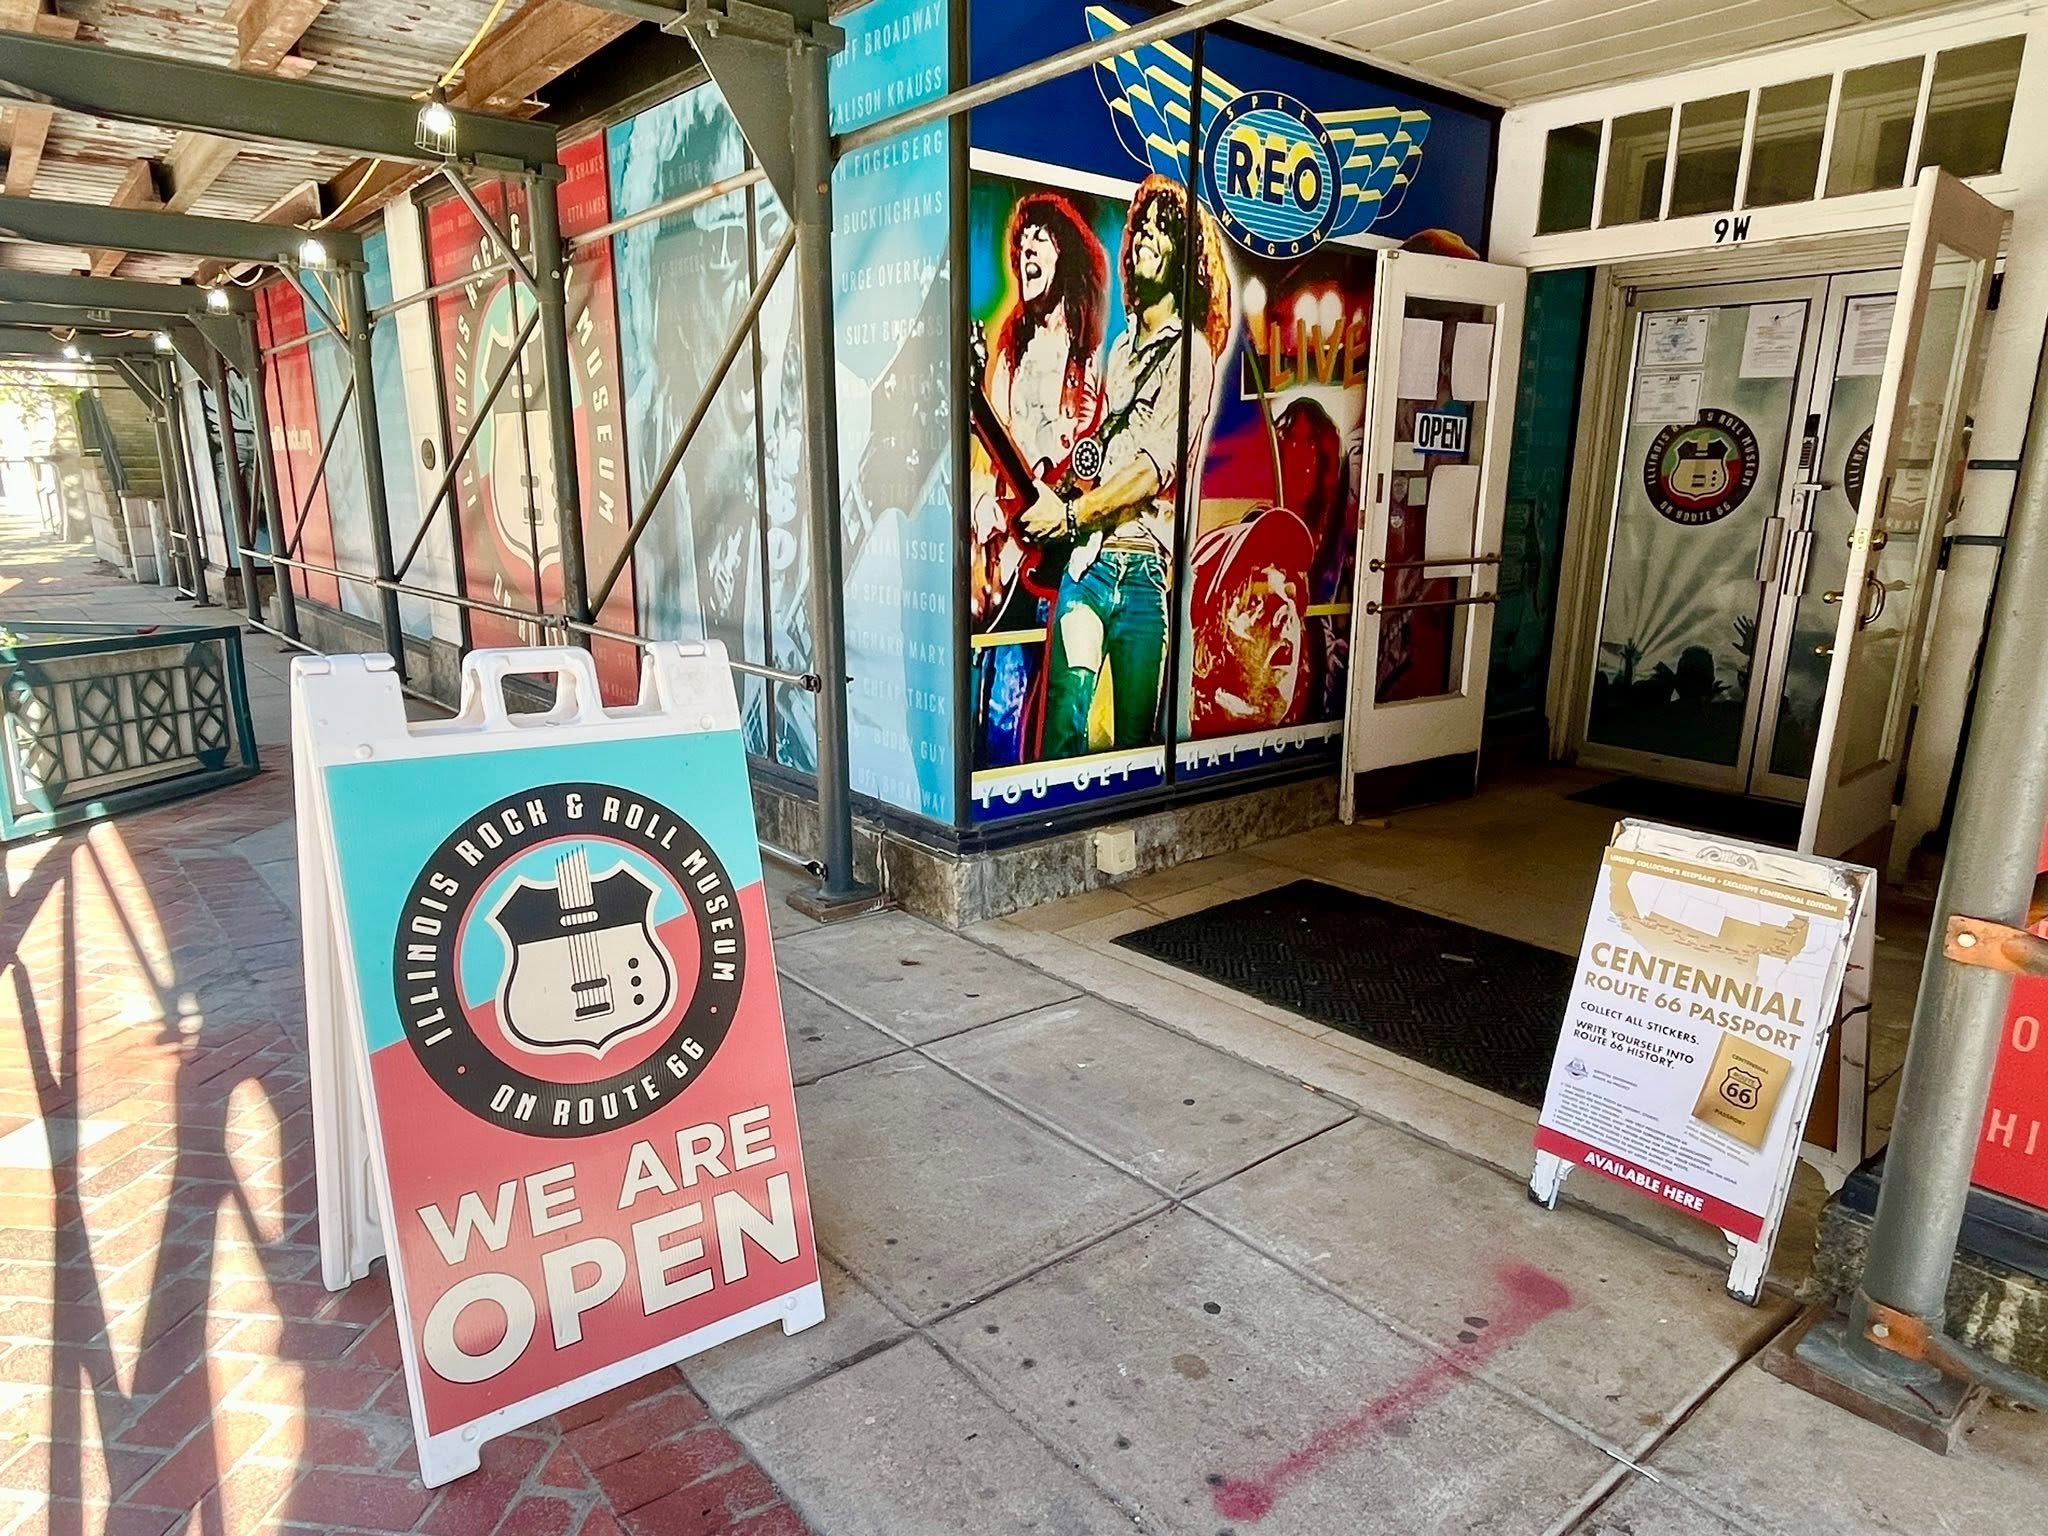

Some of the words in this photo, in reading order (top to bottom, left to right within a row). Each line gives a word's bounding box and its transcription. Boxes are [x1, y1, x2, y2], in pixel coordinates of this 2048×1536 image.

[864, 1, 941, 56] BROADWAY
[836, 88, 880, 126] ALISON
[887, 66, 942, 107] KRAUSS
[1225, 95, 1330, 145] SPEED
[854, 129, 942, 178] FOGELBERG
[842, 190, 943, 236] BUCKINGHAMS
[1221, 209, 1322, 255] WAGON
[841, 267, 873, 293] URGE
[845, 322, 876, 346] SUZY
[1269, 318, 1367, 390] LIVE
[576, 305, 616, 524] MUSEUM
[1418, 415, 1464, 450] OPEN
[1718, 414, 1744, 436] ROLL
[1741, 436, 1756, 486] MUSEUM
[1660, 501, 1673, 514] ON
[905, 539, 945, 563] ISSUE
[908, 640, 946, 667] MARX
[906, 688, 946, 716] TRICK
[920, 740, 946, 765] GUY
[981, 776, 1049, 809] YOU
[1072, 762, 1132, 788] GET
[407, 871, 460, 1047] ILLINOIS
[455, 798, 548, 867] ROCK
[565, 793, 584, 819] &
[602, 796, 682, 850] ROLL
[681, 849, 736, 982] MUSEUM
[1805, 898, 1838, 913] EDITION
[1591, 942, 1805, 1028] CENTENNIAL
[1580, 1001, 1622, 1020] COLLECT
[1625, 1015, 1643, 1027] ALL
[1646, 1021, 1700, 1045] STICKERS.
[1584, 971, 1649, 1003] ROUTE
[1654, 993, 1682, 1013] 66
[1688, 1002, 1801, 1051] PASSPORT
[1573, 1029, 1607, 1046] ROUTE
[1610, 1041, 1624, 1052] 66
[1626, 1046, 1675, 1069] HISTORY.
[1576, 1019, 1608, 1036] WRITE
[1611, 1030, 1664, 1054] YOURSELF
[1666, 1048, 1694, 1064] INTO
[489, 1083, 538, 1122] ON
[552, 1075, 660, 1126] ROUTE
[665, 1037, 705, 1080] 66
[1726, 1083, 1752, 1104] 66
[416, 1162, 583, 1266] WE
[617, 1105, 777, 1211] ARE
[1584, 1151, 1661, 1194] AVAILABLE
[1663, 1184, 1704, 1212] HERE
[422, 1172, 801, 1384] OPEN
